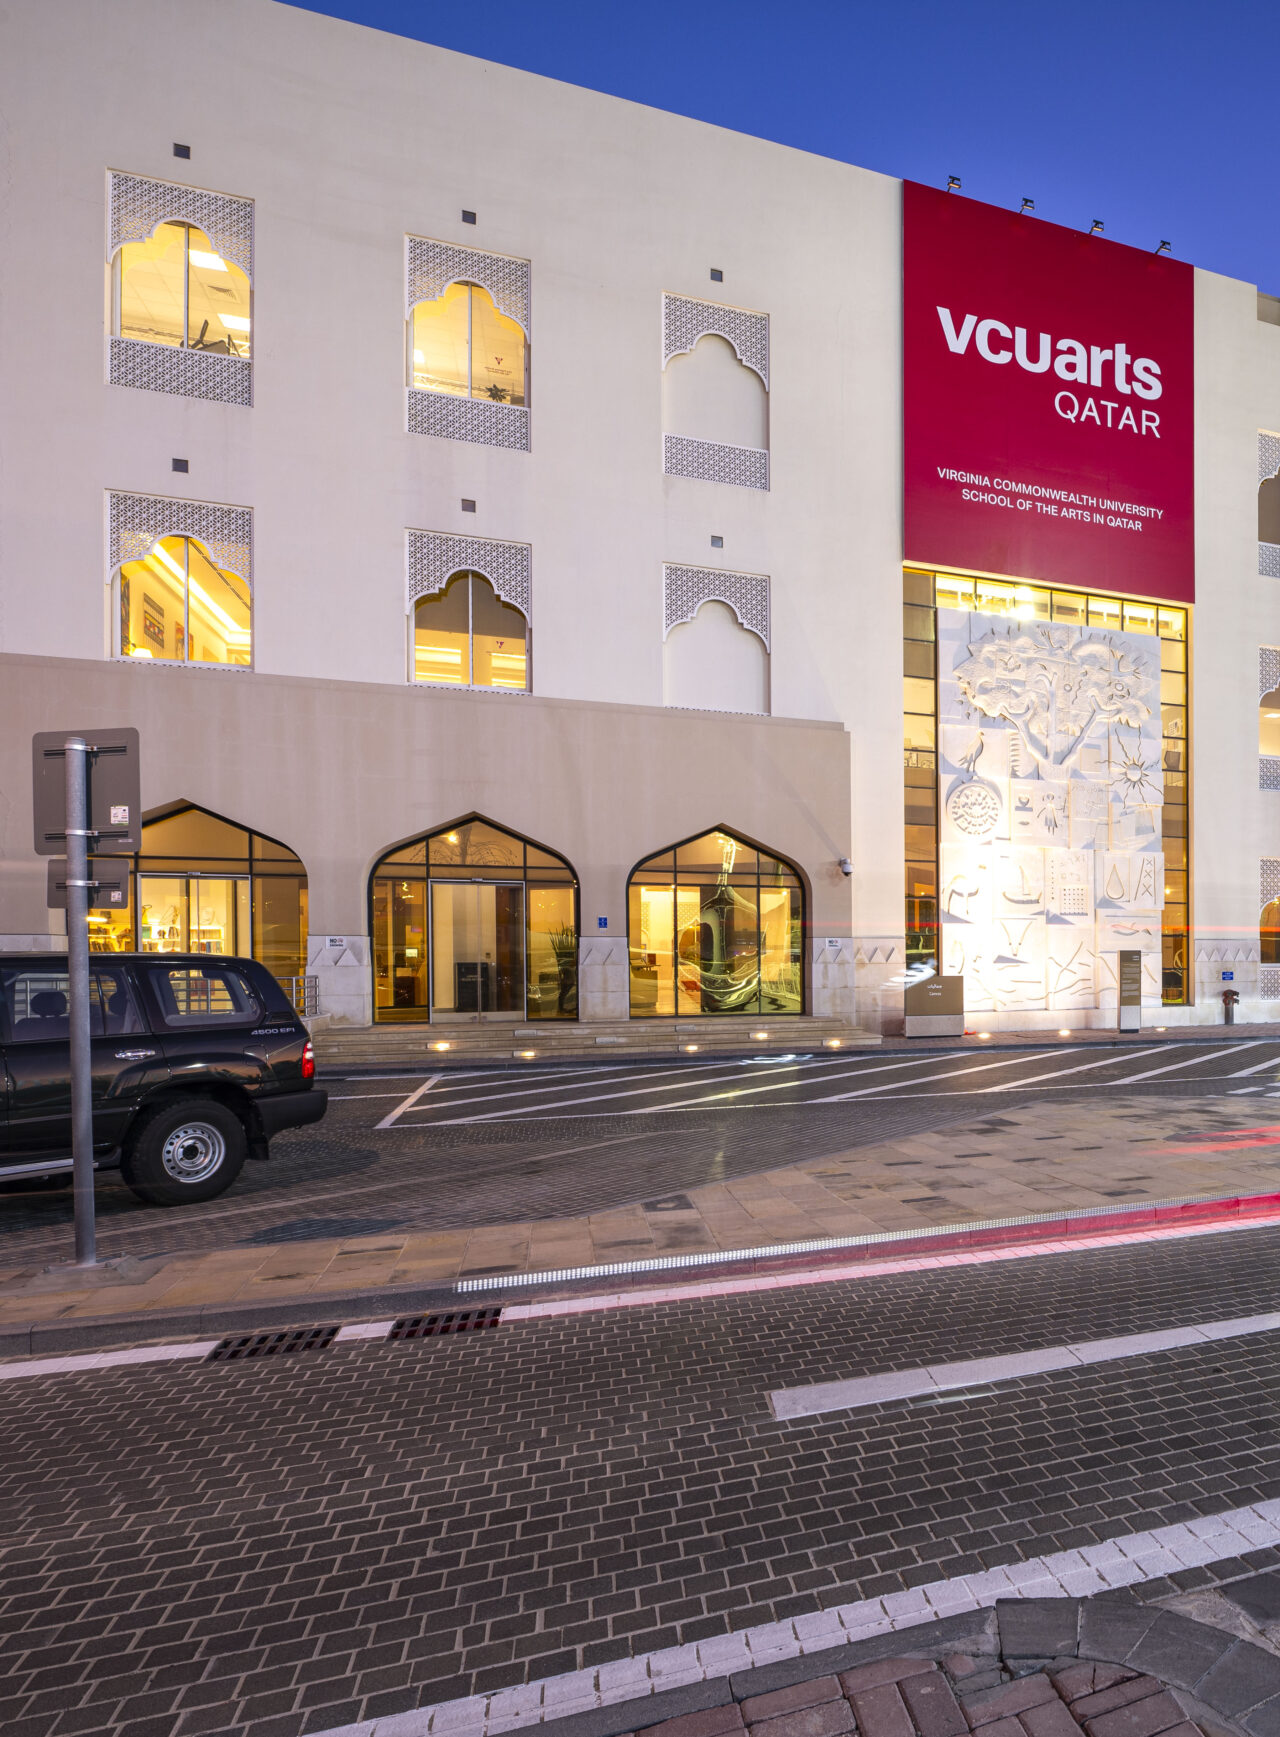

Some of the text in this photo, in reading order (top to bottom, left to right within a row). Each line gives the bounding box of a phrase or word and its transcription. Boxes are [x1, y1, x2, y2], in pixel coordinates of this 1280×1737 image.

[1054, 390, 1161, 439] QATAR
[936, 466, 1164, 520] VIRGINIA COMMONWEALTH UNIVERSITY
[961, 488, 1142, 532] SCHOOL OF THE ARTS IN QATAR
